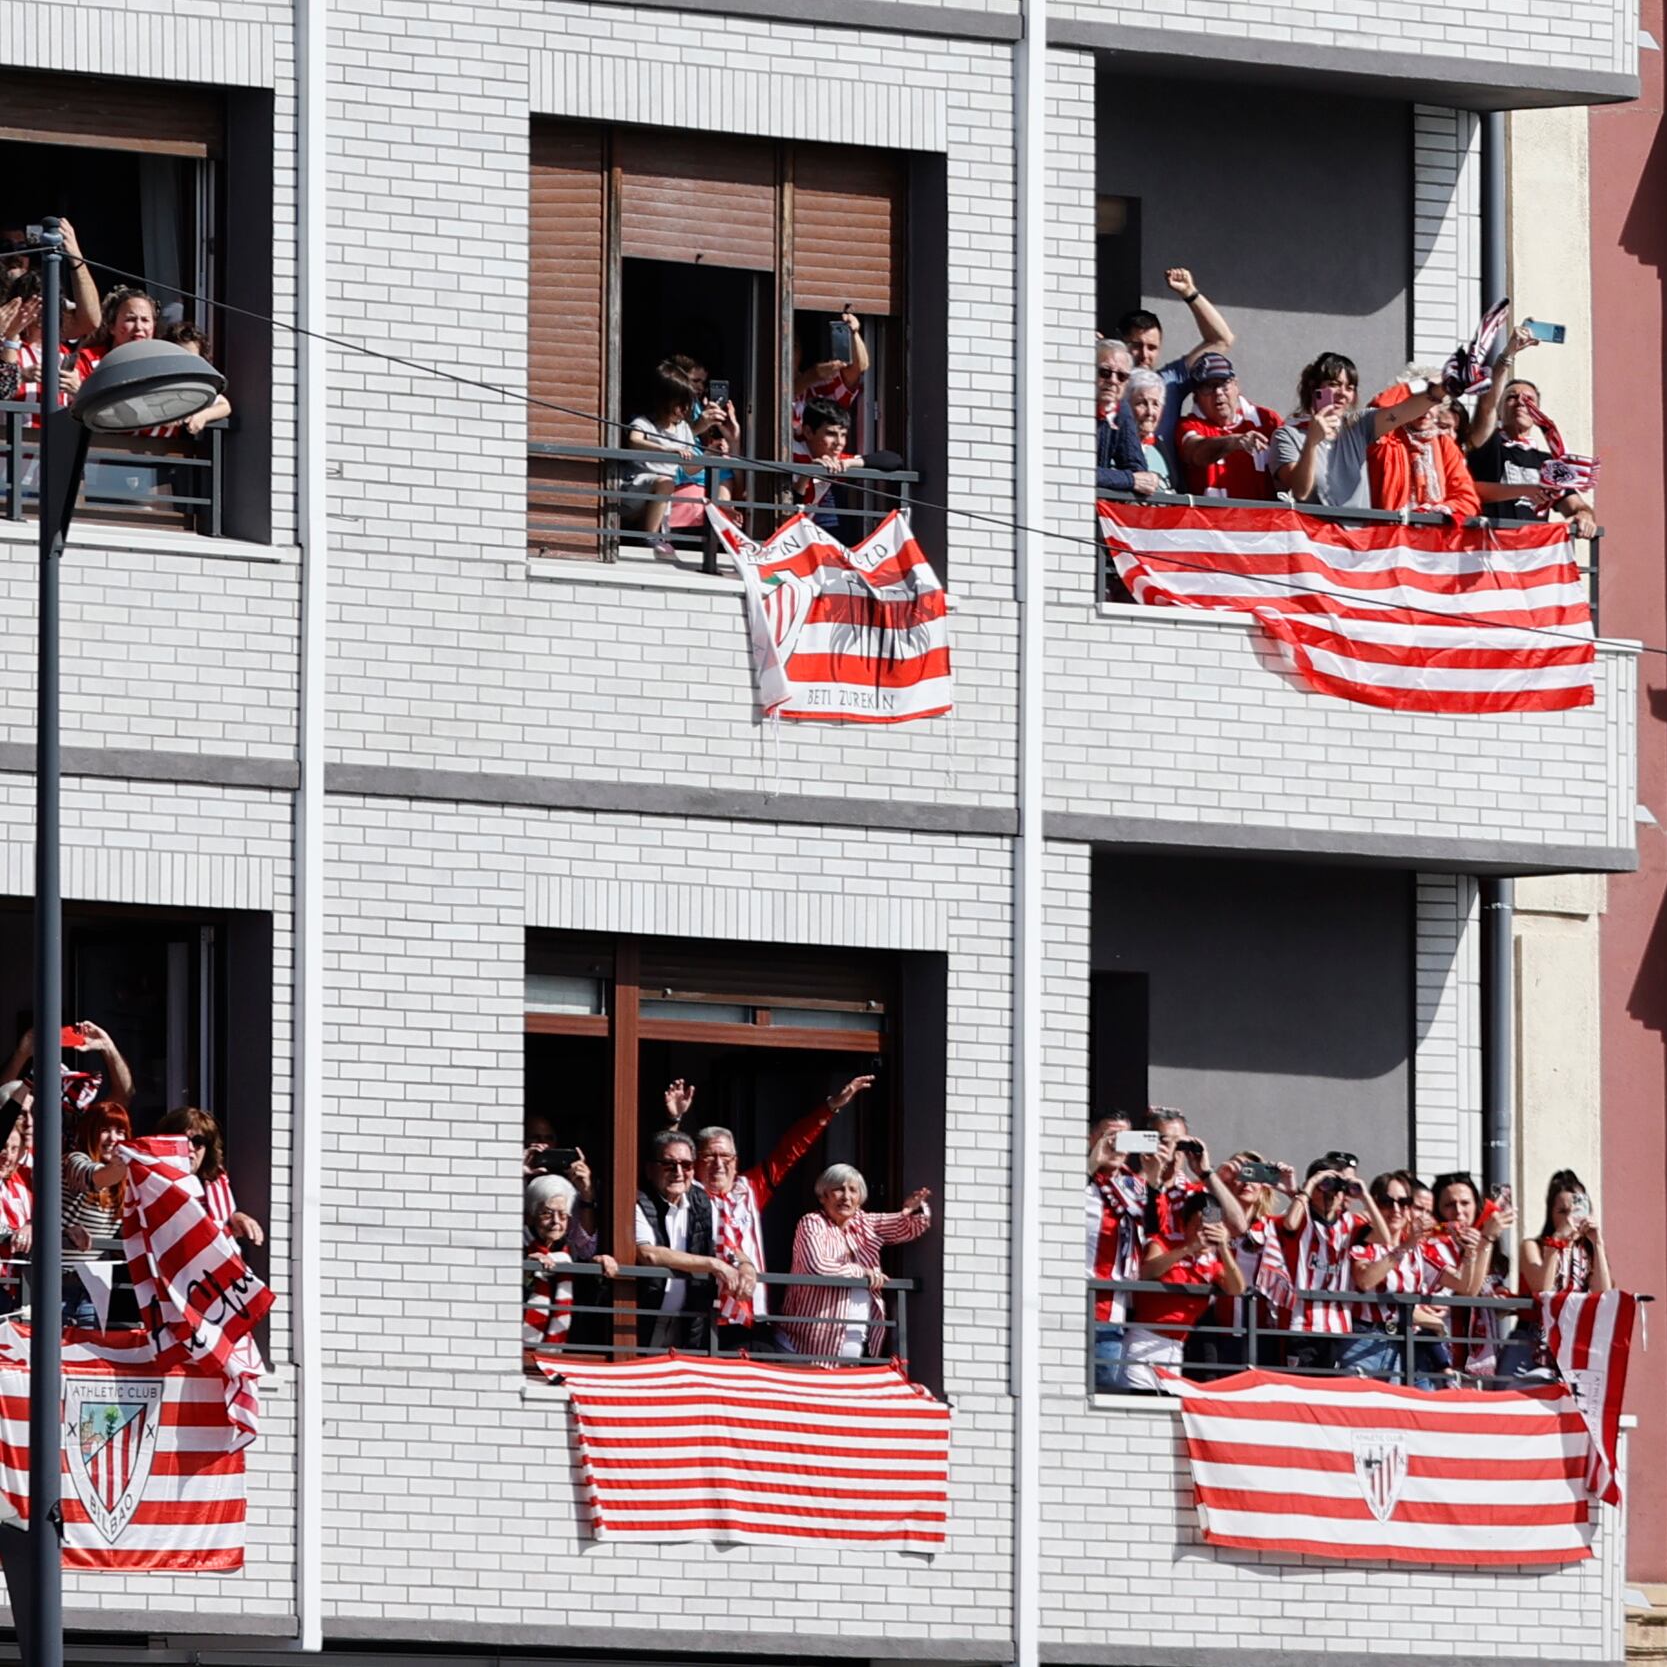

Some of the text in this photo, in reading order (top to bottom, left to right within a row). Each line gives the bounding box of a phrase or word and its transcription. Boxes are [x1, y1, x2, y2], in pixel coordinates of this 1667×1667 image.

[808, 689, 832, 705] BETI
[72, 1386, 158, 1399] ATHLETIC CLUB
[90, 1493, 133, 1535] BILBAO
